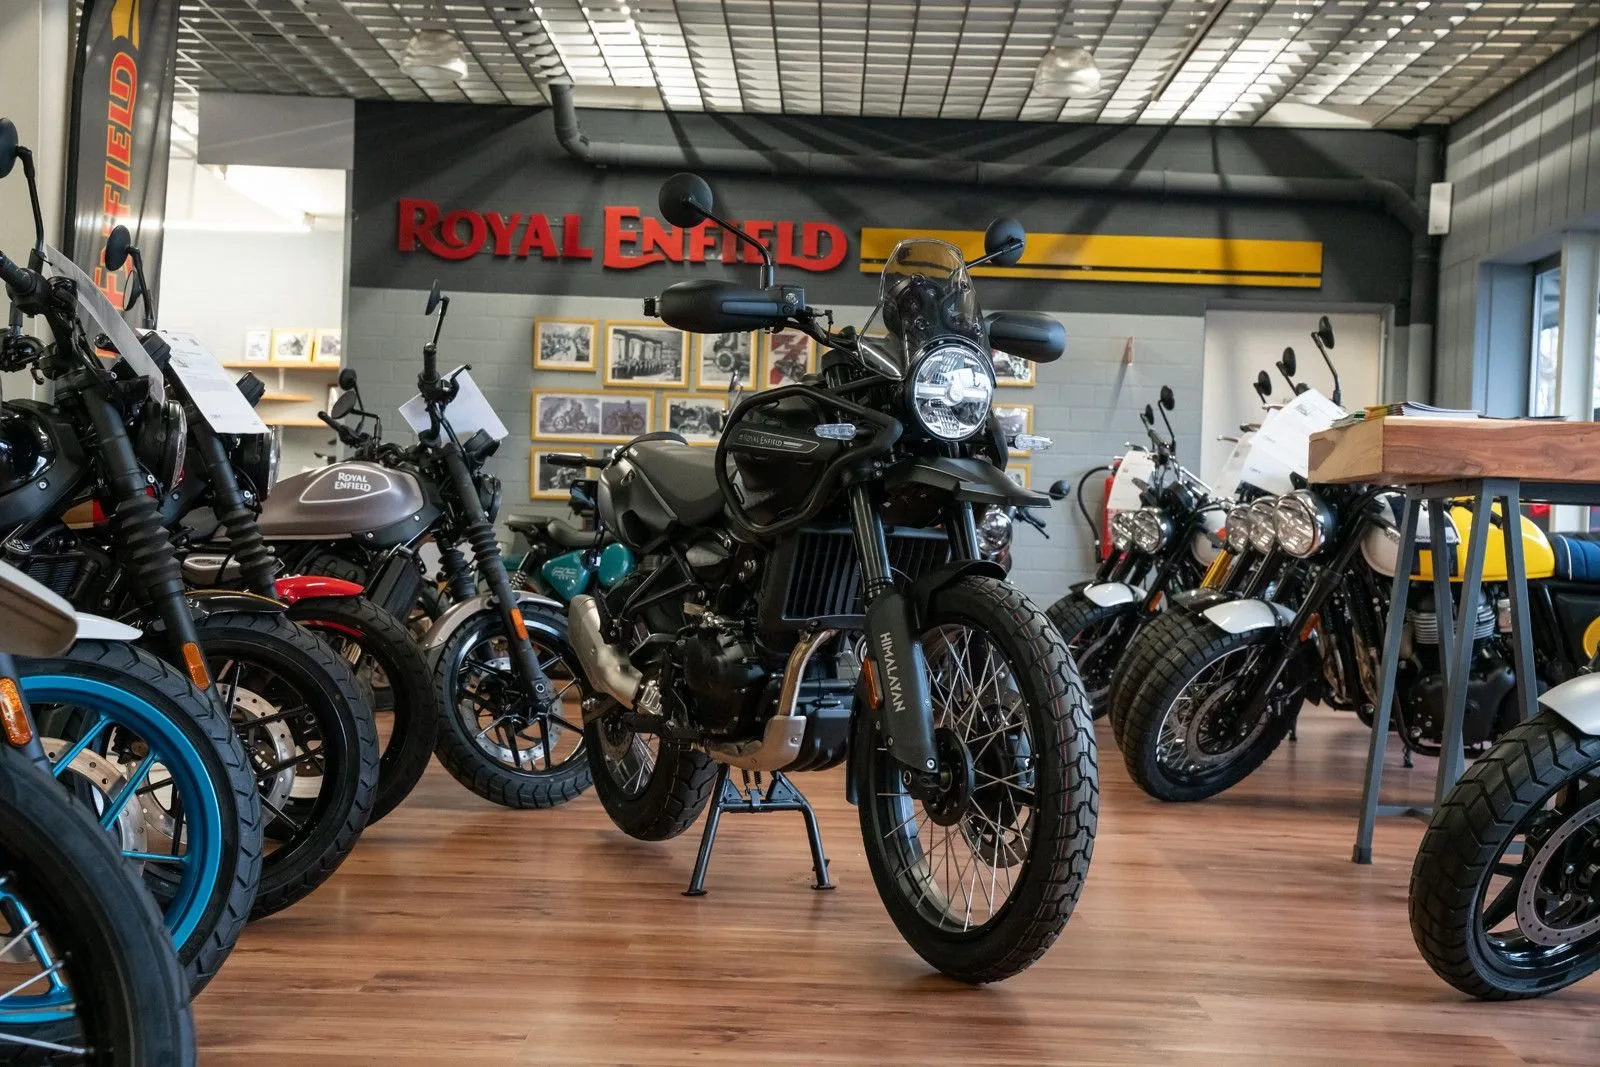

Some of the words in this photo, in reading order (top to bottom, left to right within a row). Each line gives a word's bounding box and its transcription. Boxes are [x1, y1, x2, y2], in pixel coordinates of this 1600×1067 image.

[94, 51, 137, 311] EFIELD
[398, 197, 594, 260] ROYAL
[603, 206, 847, 272] ENFIELD
[760, 436, 782, 447] ENFIELD
[334, 481, 372, 492] ENFIELD
[337, 471, 368, 483] ROYAL
[880, 632, 906, 712] HIMALAYAN
